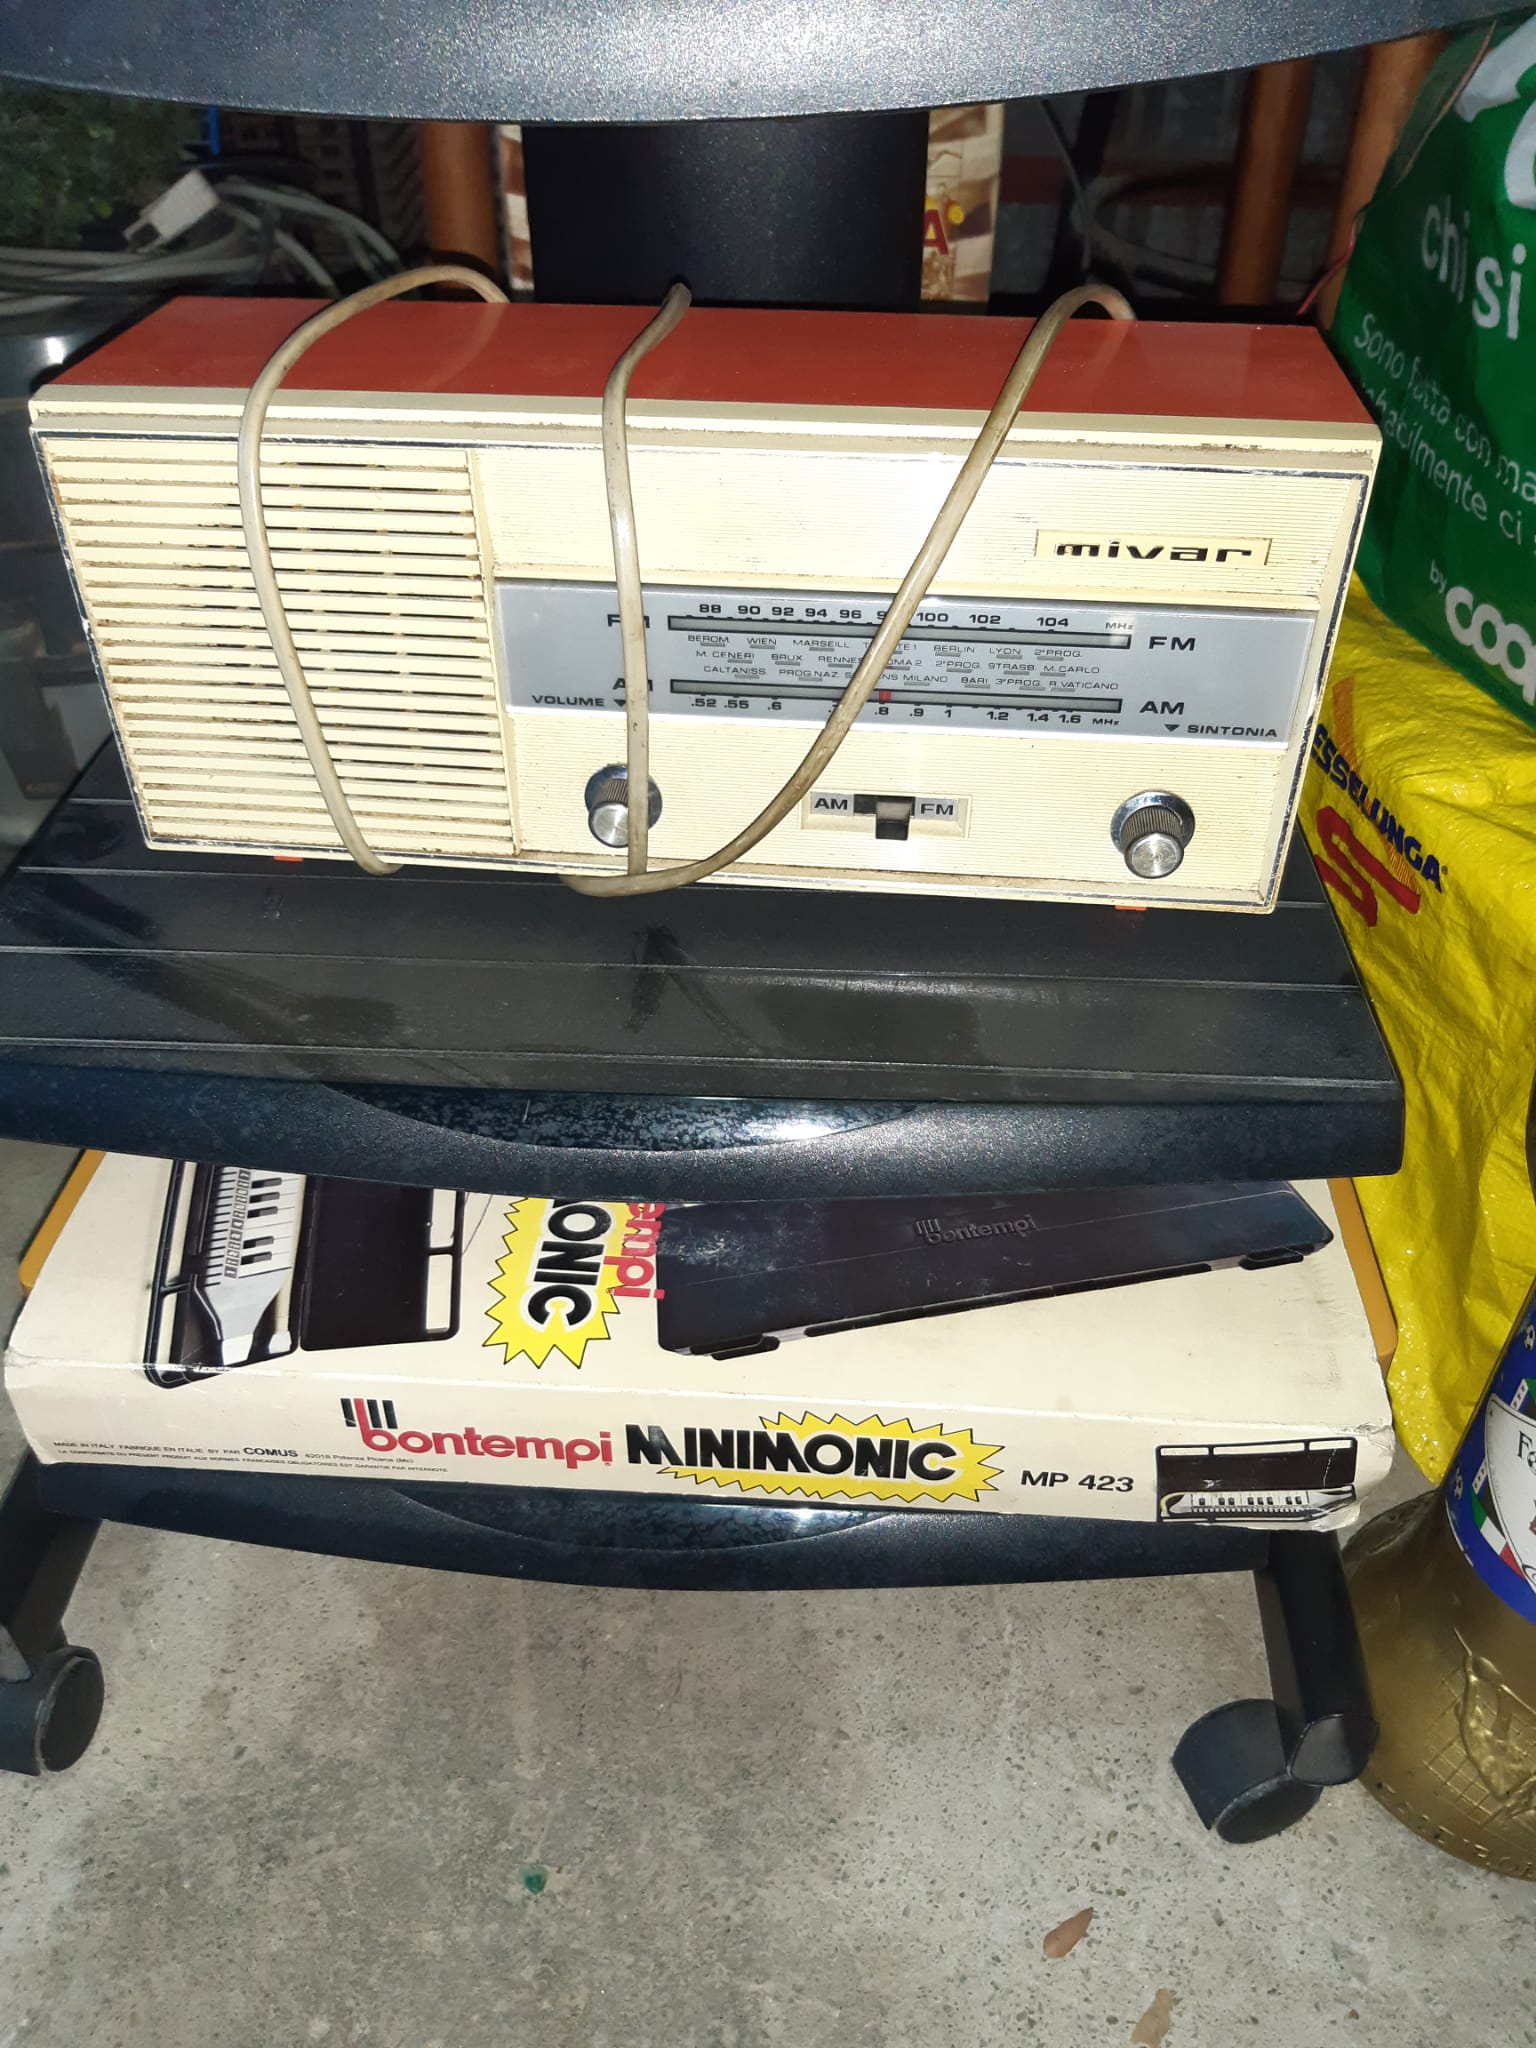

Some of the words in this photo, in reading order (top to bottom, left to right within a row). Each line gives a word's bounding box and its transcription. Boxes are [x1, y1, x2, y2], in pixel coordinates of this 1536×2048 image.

[1472, 243, 1527, 340] si
[1354, 312, 1404, 381] Sono
[1454, 411, 1491, 468] con
[1055, 539, 1252, 563] mivar
[1428, 560, 1448, 595] by
[607, 614, 650, 629] F
[699, 604, 722, 614] 88
[737, 605, 761, 615] 90
[771, 606, 794, 617] 92
[805, 608, 828, 618] 94
[839, 609, 862, 619] 96
[876, 610, 889, 620] 9
[916, 612, 949, 622] 100
[969, 614, 1001, 625] 102
[1036, 617, 1069, 628] 104
[1105, 621, 1134, 631] MHz
[1148, 636, 1196, 651] FM
[746, 637, 777, 646] WIEN
[933, 644, 975, 653] BERLIN
[989, 646, 1022, 656] LYON
[711, 651, 755, 660] CENERI
[1058, 665, 1100, 674] CARLO
[902, 674, 948, 684] MILANO
[532, 695, 605, 707] VOLUME
[691, 698, 717, 708] .52
[724, 700, 749, 710] .55
[767, 701, 782, 711] .6
[874, 707, 889, 715] .8
[909, 708, 924, 717] .9
[944, 710, 952, 718] 1
[986, 711, 1009, 721] 1.2
[1027, 713, 1049, 723] 1.4
[1058, 714, 1081, 724] 1.6
[1092, 717, 1120, 726] MHz
[1139, 700, 1185, 715] AM
[1186, 724, 1278, 738] SINTONIA
[813, 798, 848, 811] AM
[920, 803, 954, 816] FM
[913, 1213, 1037, 1246] bontempi
[341, 1398, 614, 1470] bontempi
[626, 1423, 957, 1481] MINIMONIC
[243, 1446, 298, 1458] COMUS
[1020, 1469, 1070, 1489] MP
[1077, 1474, 1134, 1493] 423
